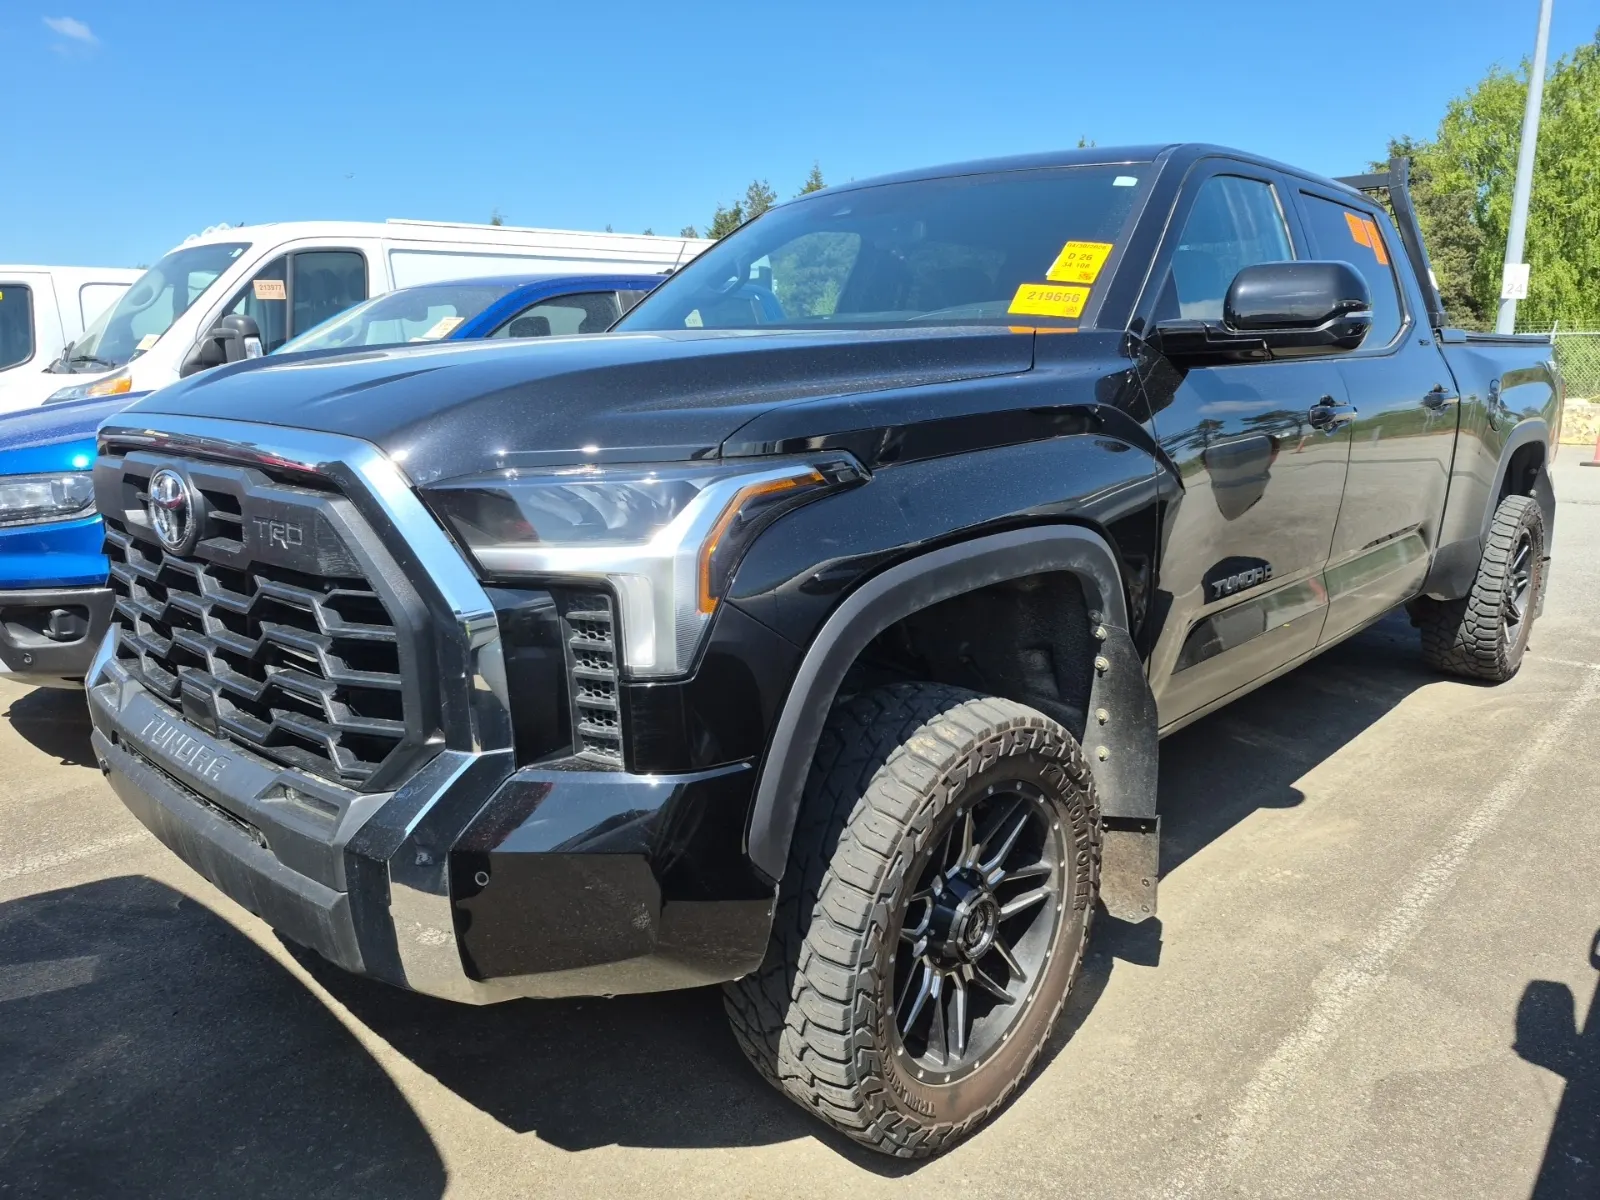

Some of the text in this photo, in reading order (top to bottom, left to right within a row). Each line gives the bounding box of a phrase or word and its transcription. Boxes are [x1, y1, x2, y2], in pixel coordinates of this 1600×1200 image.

[1079, 253, 1092, 261] 26
[1027, 290, 1081, 303] 219656
[1506, 283, 1523, 295] 24
[253, 516, 303, 550] TRD
[1211, 564, 1273, 598] TUNDRA
[141, 714, 232, 782] TUNDRA
[1056, 773, 1091, 911] VENOM POWER
